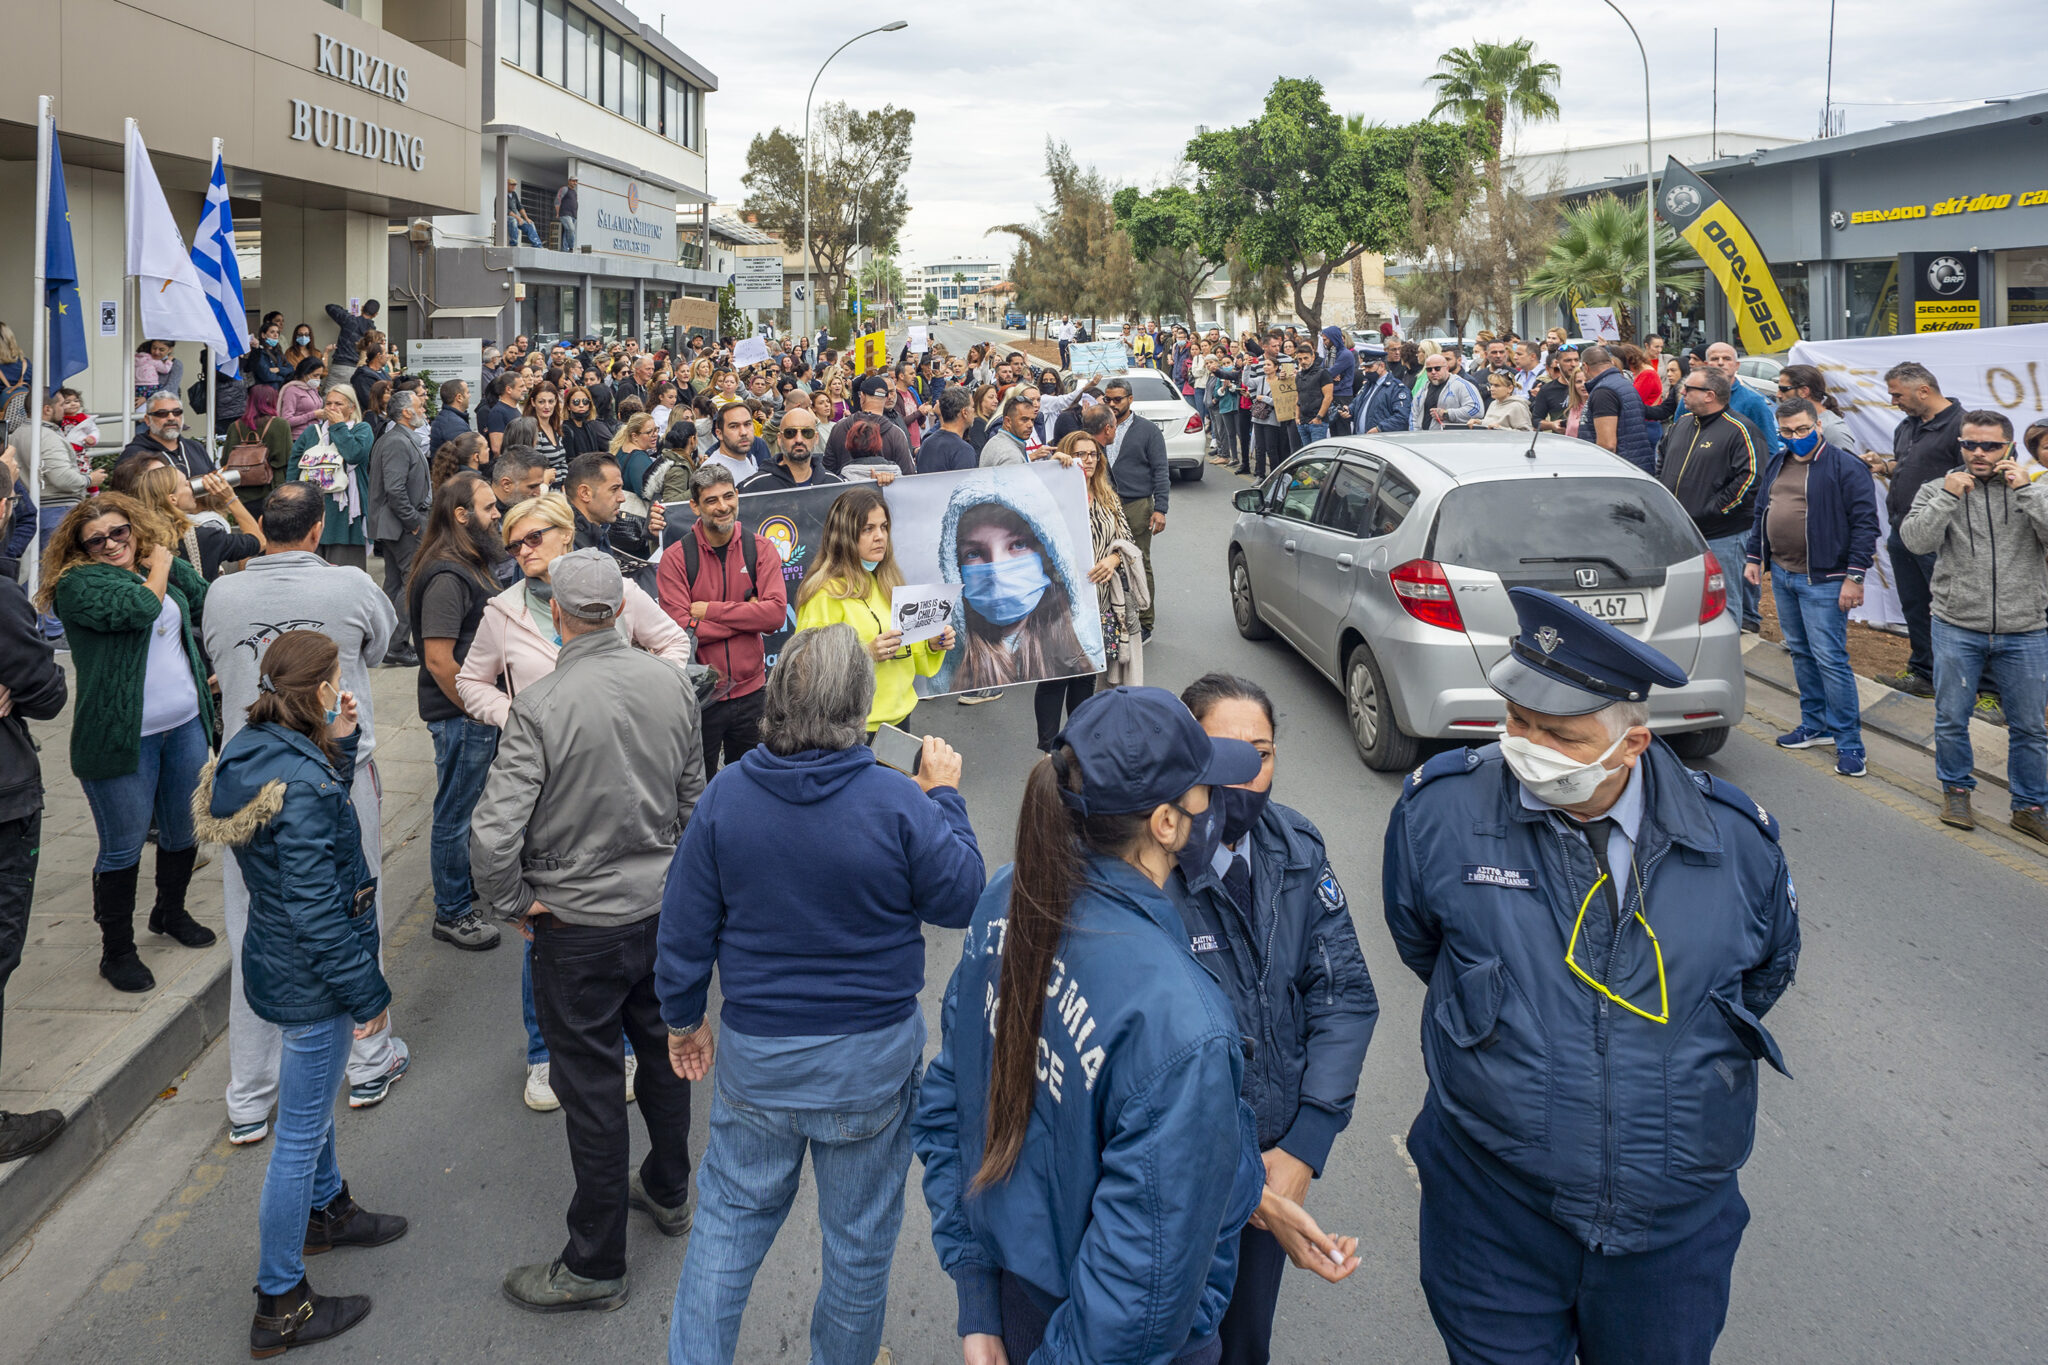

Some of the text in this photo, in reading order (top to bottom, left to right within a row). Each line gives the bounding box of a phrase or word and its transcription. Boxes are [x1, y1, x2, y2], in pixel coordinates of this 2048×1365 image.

[315, 32, 409, 104] KIRZIS
[289, 98, 426, 172] BUILDING
[1931, 193, 2012, 216] ski-doo
[597, 208, 632, 234] SALAMIS
[917, 608, 937, 620] CHILD
[920, 598, 938, 609] THIS IS
[1593, 597, 1627, 618] 167
